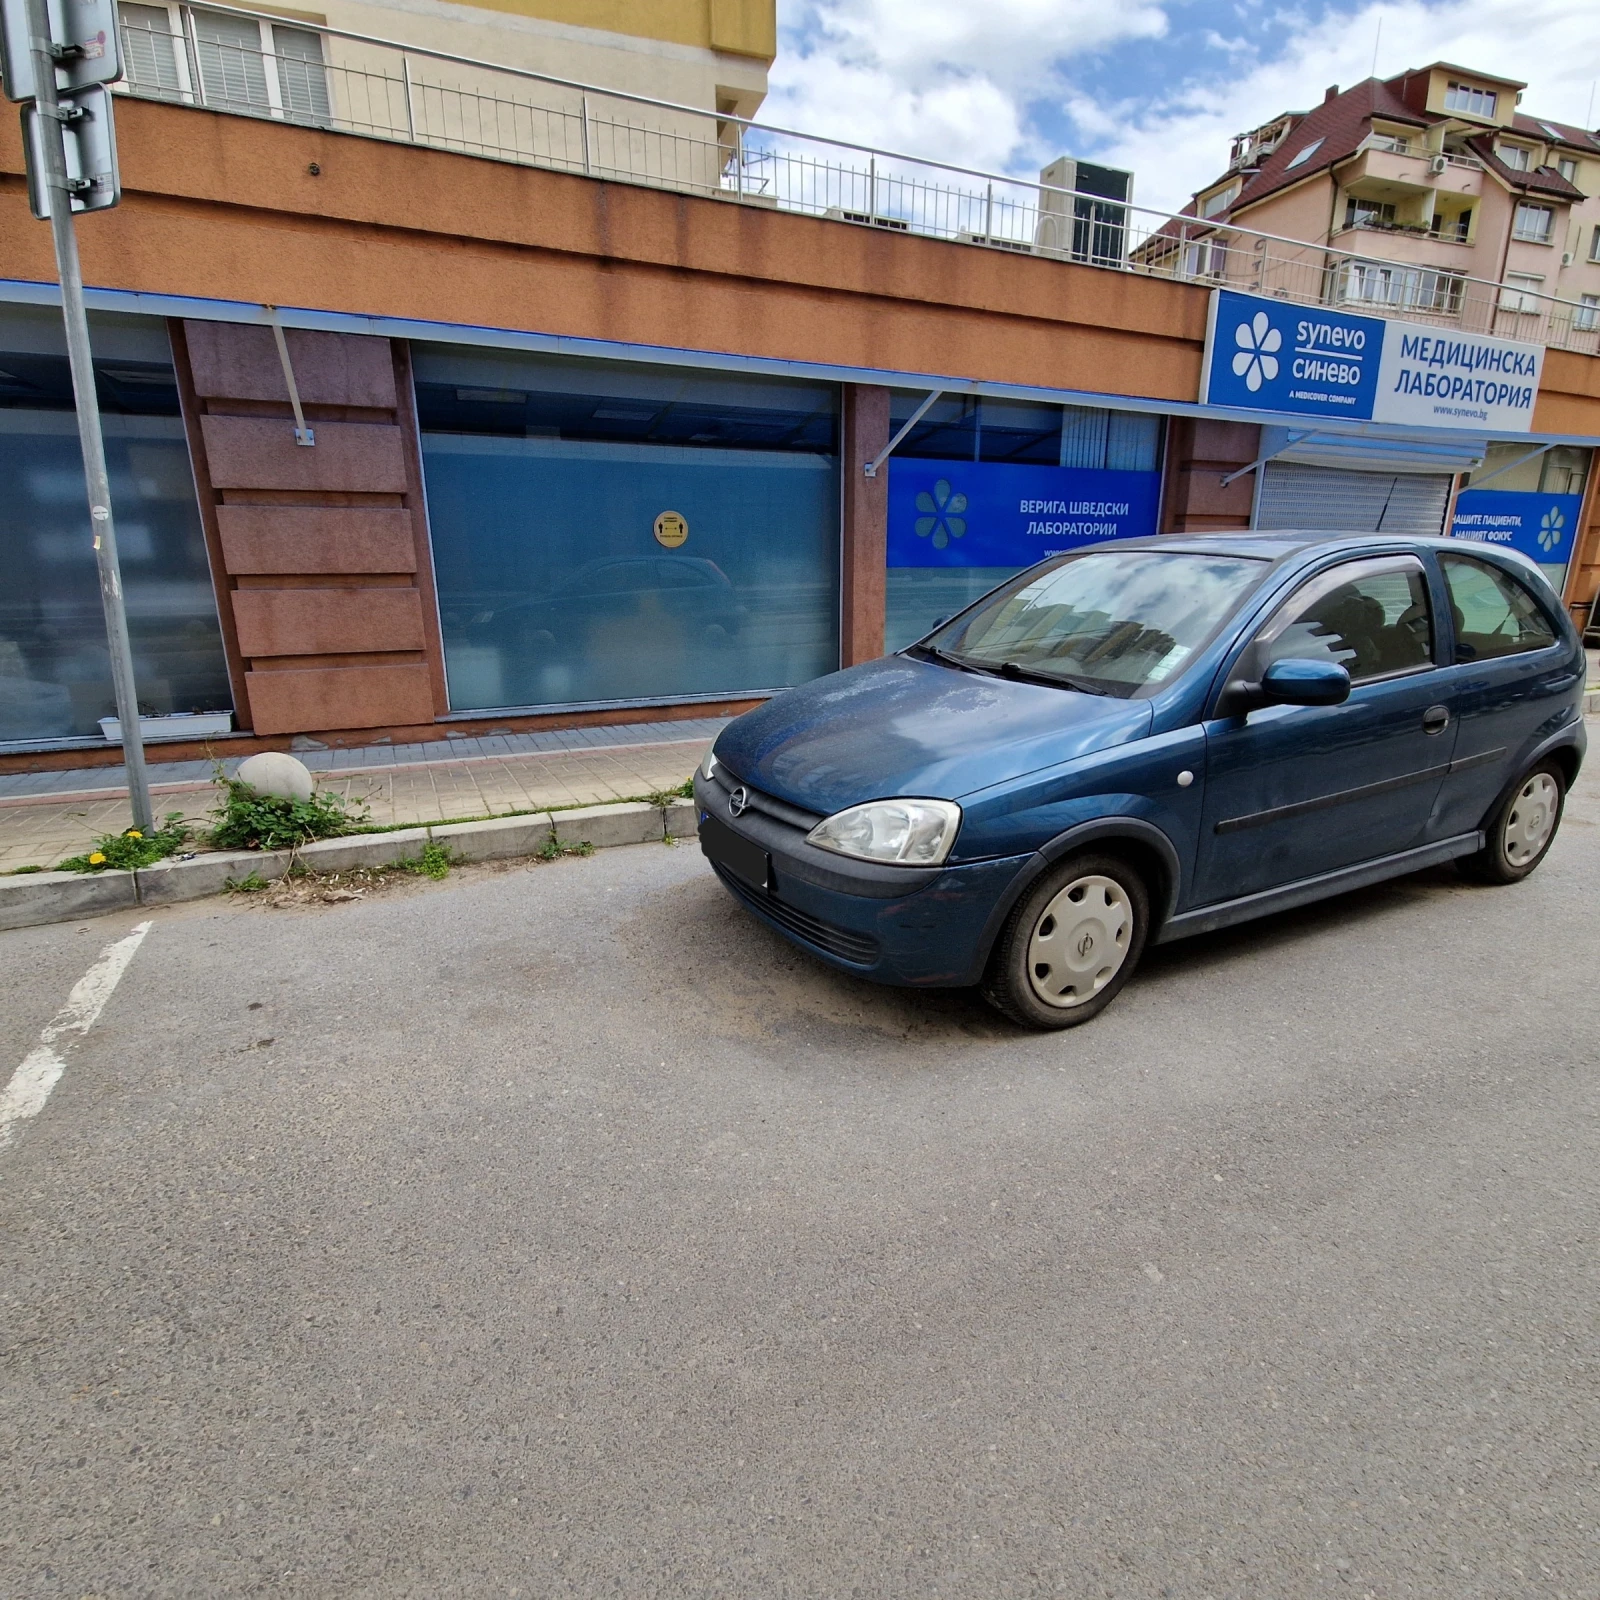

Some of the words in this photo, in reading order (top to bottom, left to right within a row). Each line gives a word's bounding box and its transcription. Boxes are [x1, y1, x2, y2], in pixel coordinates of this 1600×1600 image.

[1296, 321, 1365, 350] synevo
[1400, 334, 1535, 377] МЕДИЦИНСКА
[1289, 390, 1295, 398] A
[1295, 391, 1328, 402] MEDICOVER
[1328, 394, 1356, 405] COMPANY
[1394, 369, 1532, 409] ЛАБОРАТОРИЯ
[1433, 405, 1488, 421] www.synevo.bg
[1020, 500, 1067, 514] ВЕРИГА
[1069, 501, 1129, 518] ШВЕДСКИ
[1026, 521, 1117, 536] ЛАБОРАТОРИИ
[1487, 531, 1513, 541] ФОКУС
